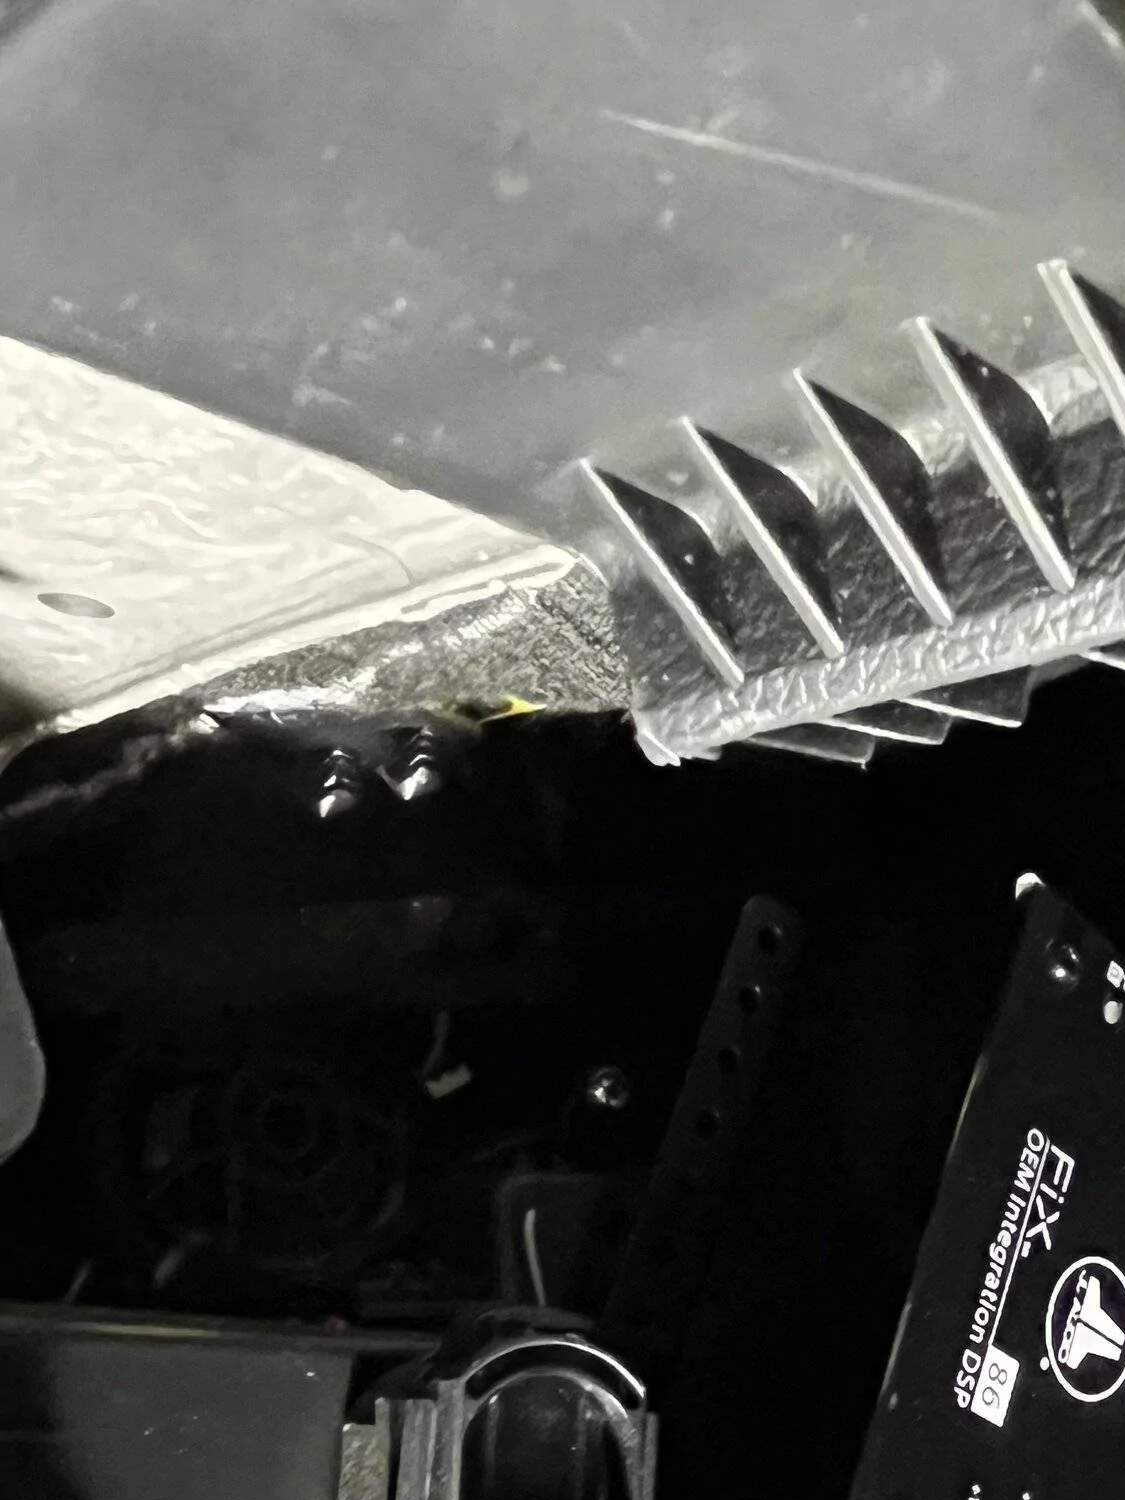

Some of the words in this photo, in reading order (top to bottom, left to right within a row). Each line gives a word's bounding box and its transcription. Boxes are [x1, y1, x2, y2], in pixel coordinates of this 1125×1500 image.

[1014, 1128, 1044, 1192] OEM
[1026, 1145, 1075, 1250] FiX
[969, 1194, 1026, 1343] Integration
[954, 1349, 982, 1408] DSP
[982, 1363, 1008, 1410] 86
